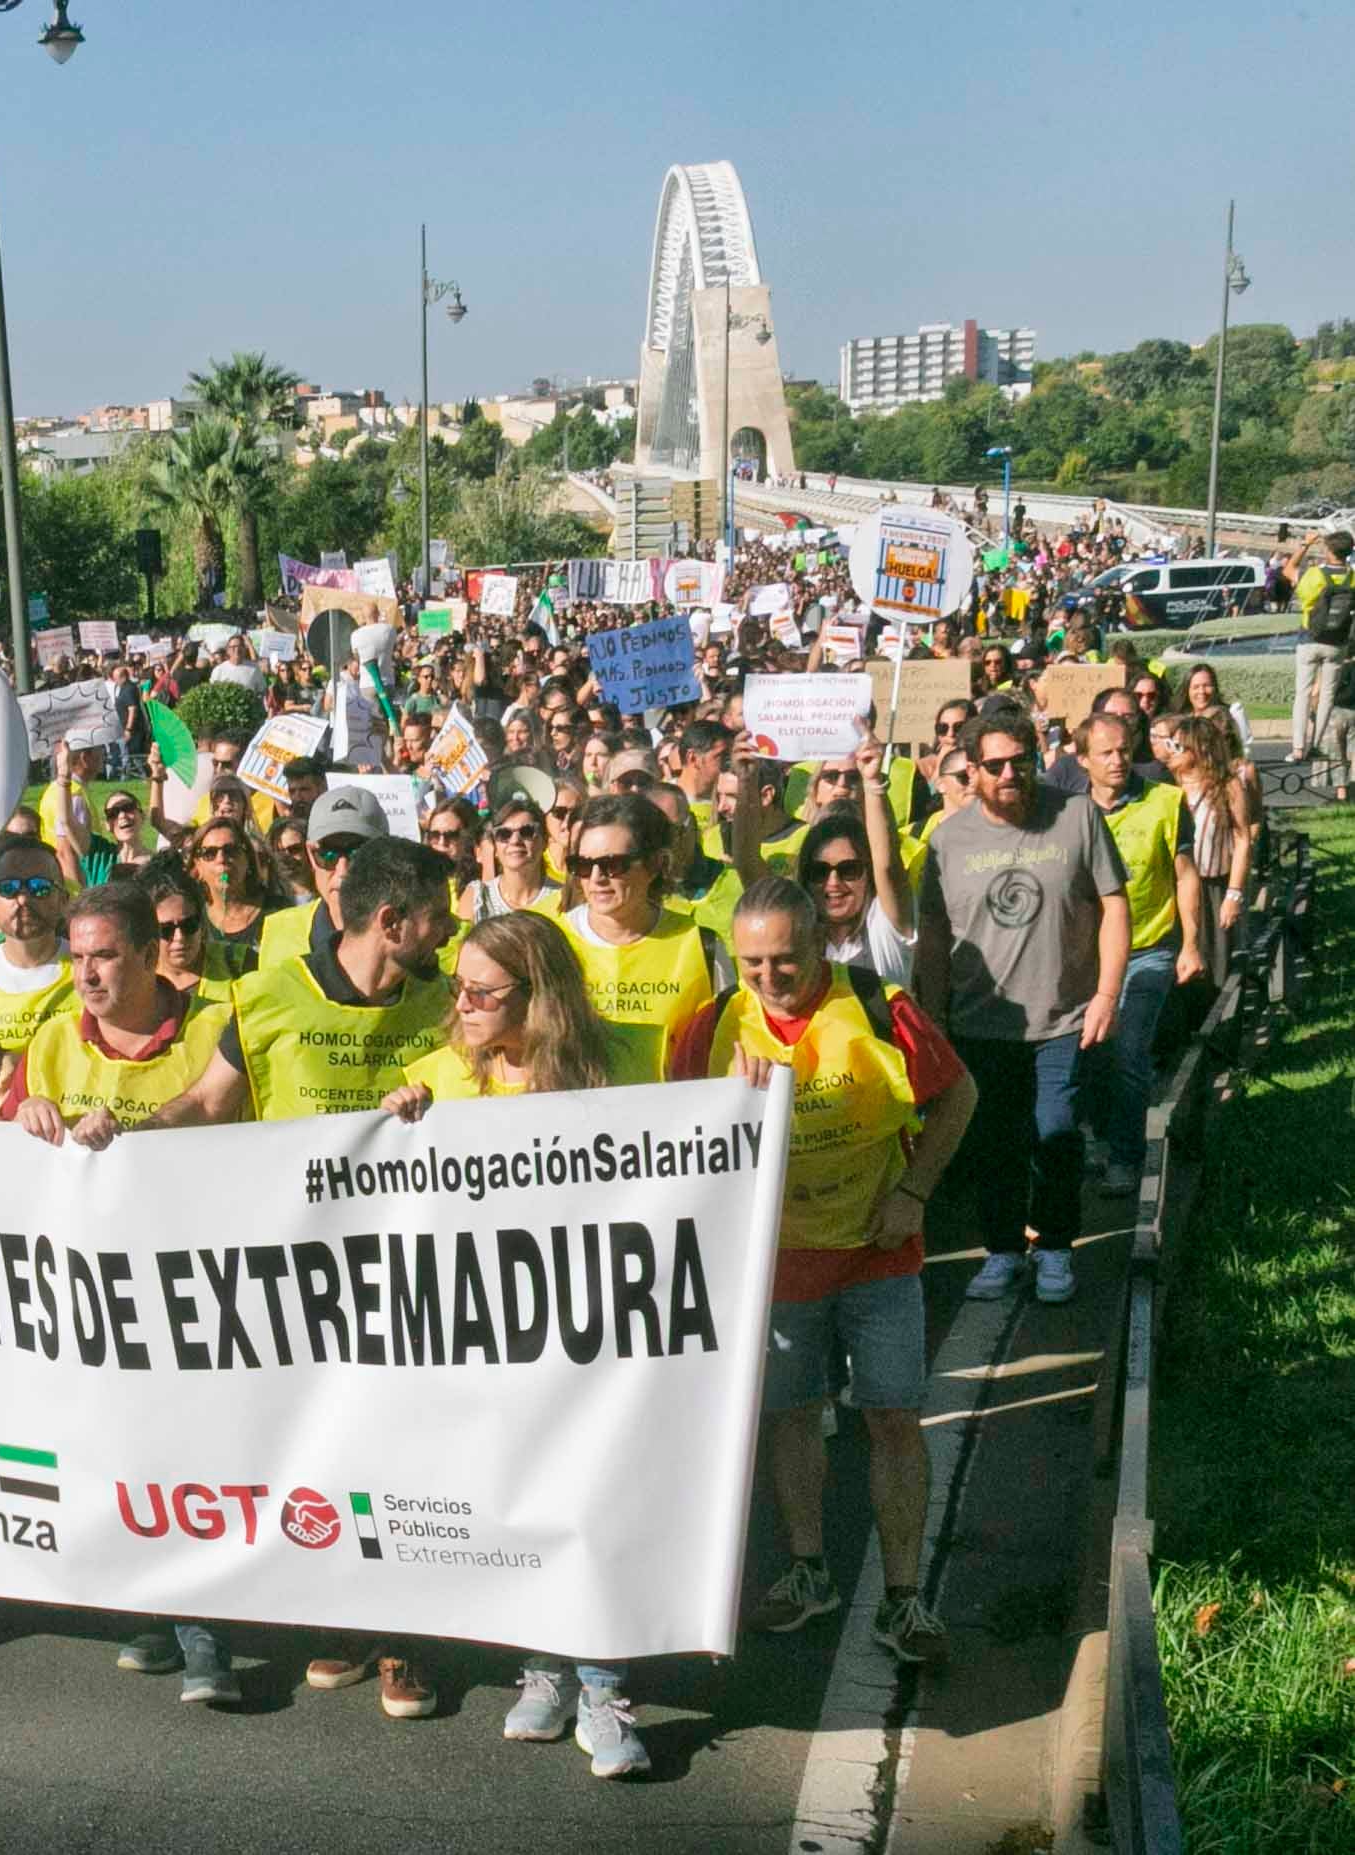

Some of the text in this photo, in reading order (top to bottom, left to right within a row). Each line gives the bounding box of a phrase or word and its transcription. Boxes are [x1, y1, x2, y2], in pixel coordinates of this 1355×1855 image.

[299, 1031, 434, 1049] HOMOLOGACIÓN
[328, 1052, 408, 1067] SALARIAL
[299, 1087, 374, 1102] DOCENTES
[66, 1246, 152, 1370] DE
[156, 1217, 720, 1371] EXTREMADURA
[116, 1481, 270, 1546] UGT
[383, 1494, 473, 1516] Servicios
[389, 1519, 472, 1541] Públicos
[397, 1543, 544, 1570] Extremadura
